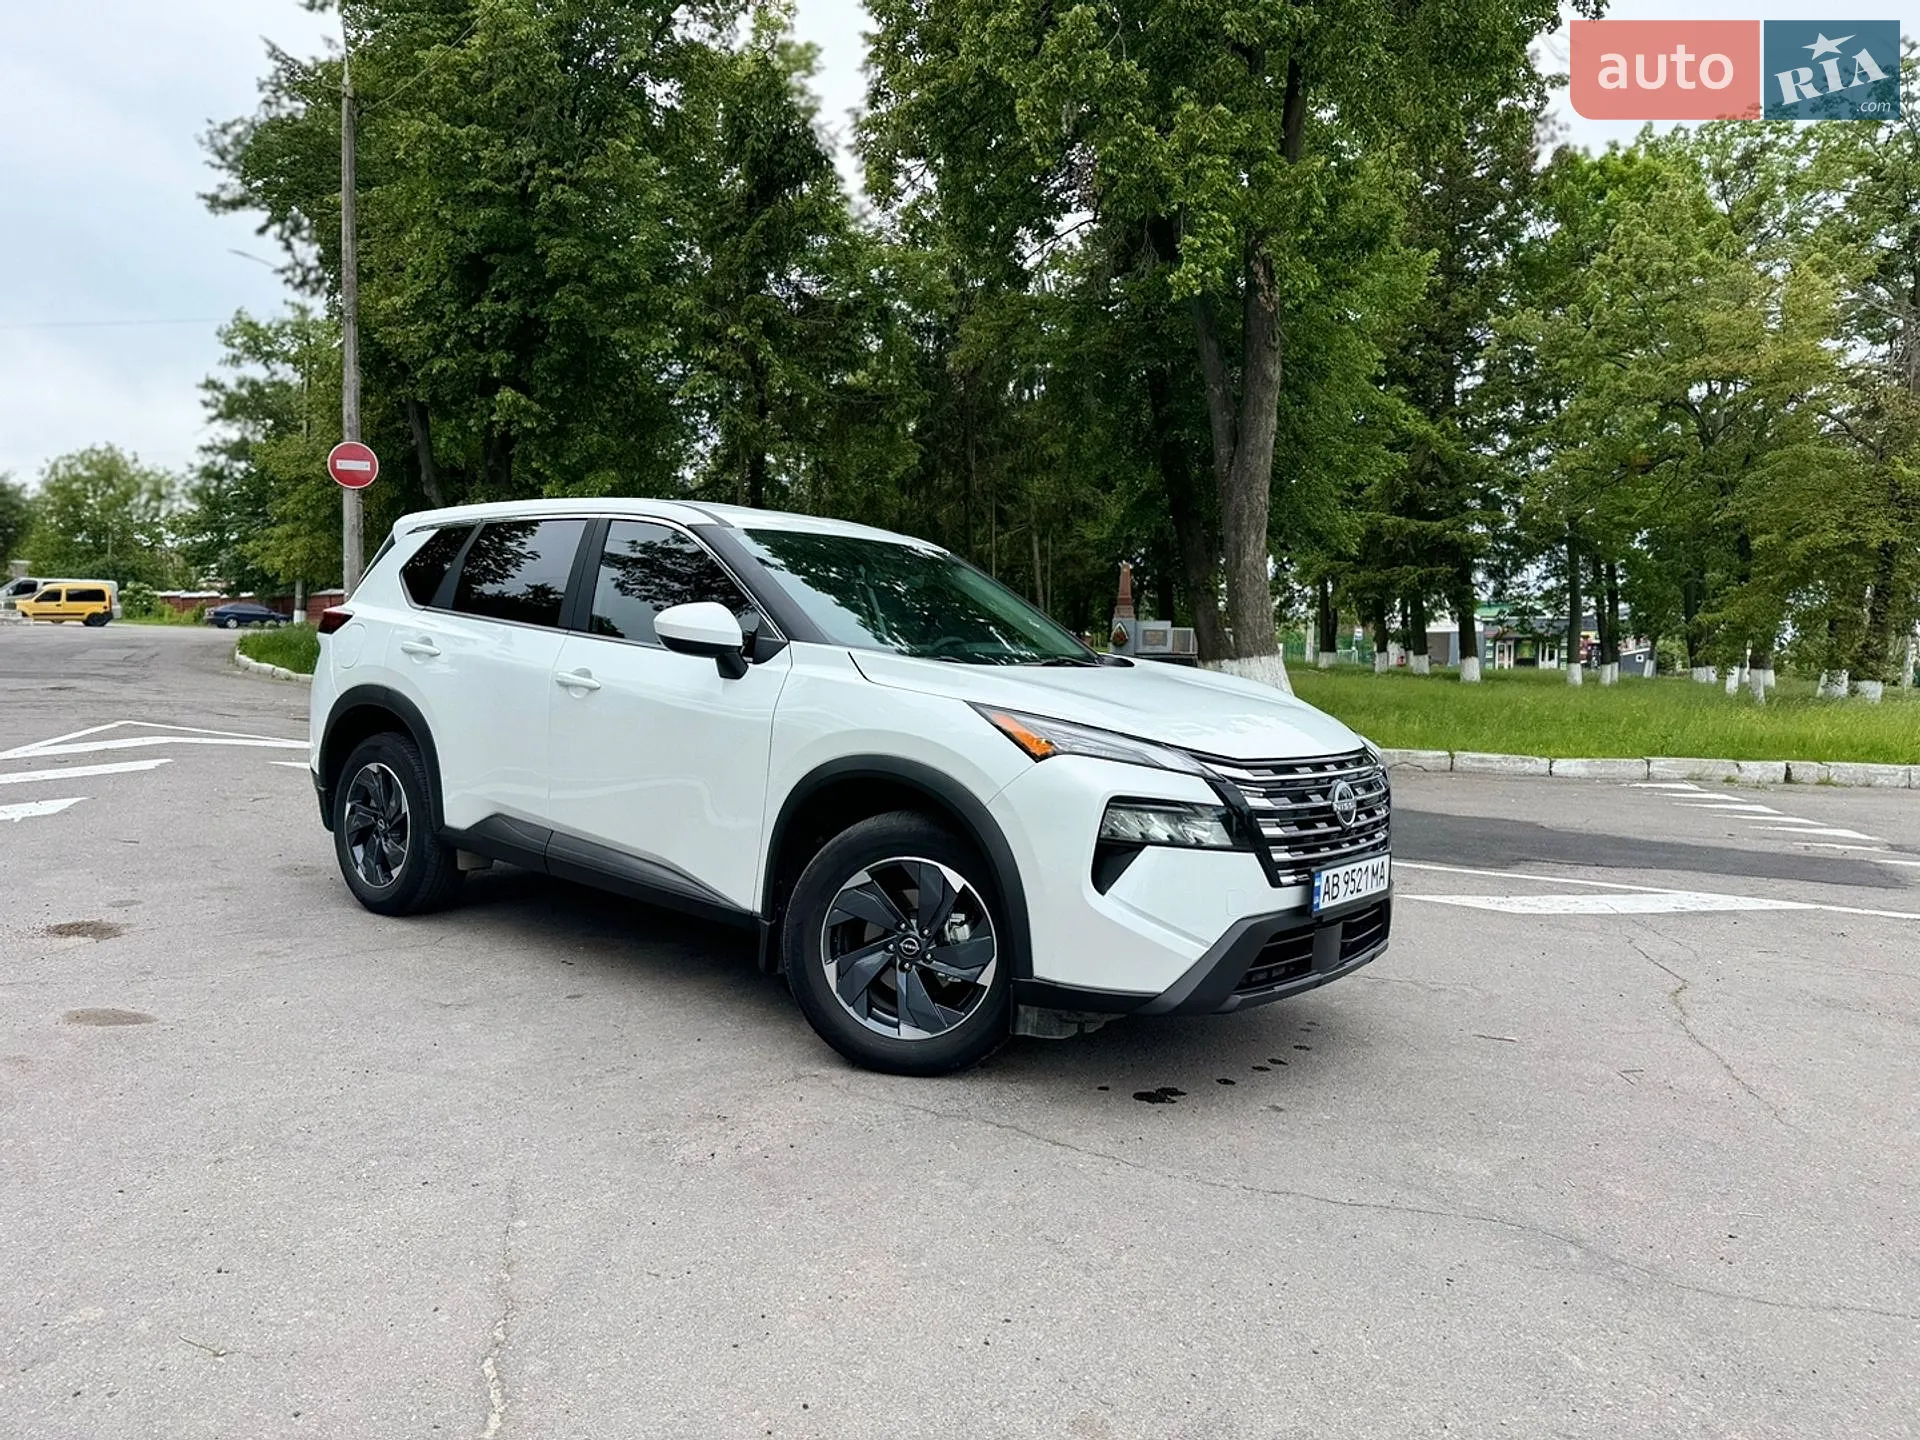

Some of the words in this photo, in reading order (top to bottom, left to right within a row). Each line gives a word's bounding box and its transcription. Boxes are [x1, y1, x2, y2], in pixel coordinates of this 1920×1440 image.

[1322, 873, 1340, 903] AB
[1343, 865, 1369, 897] 9521
[1371, 861, 1385, 889] MA
